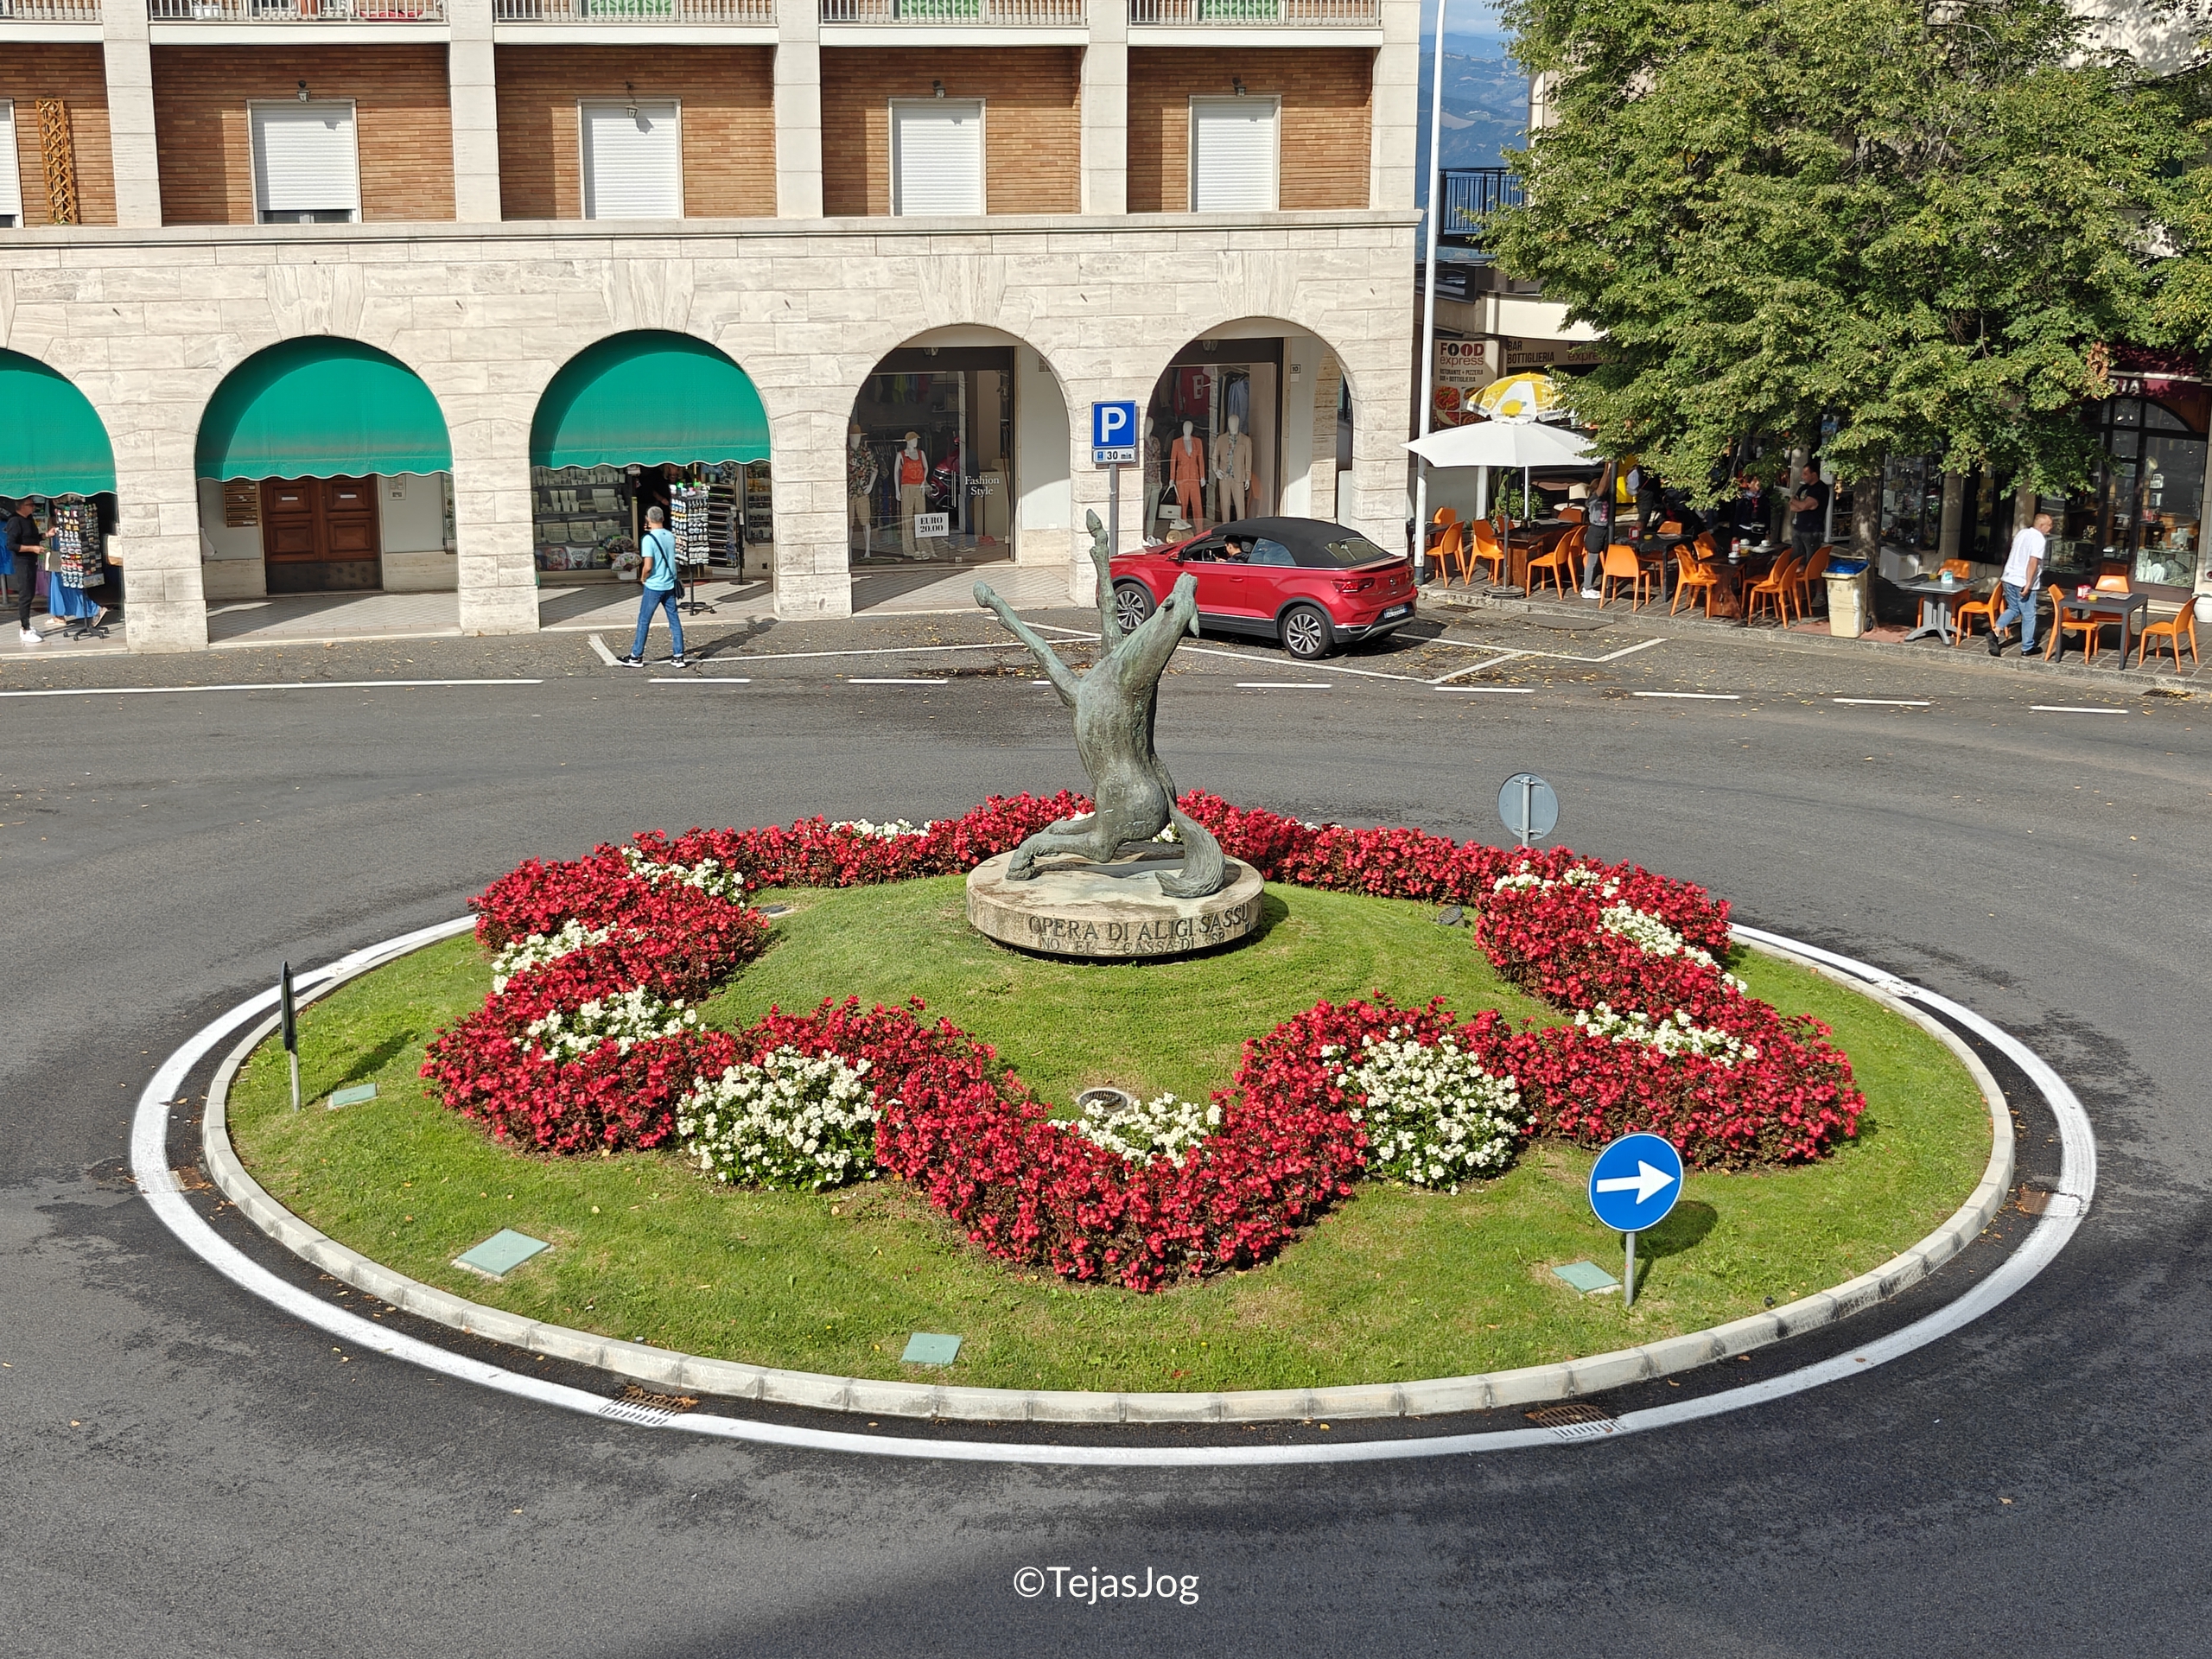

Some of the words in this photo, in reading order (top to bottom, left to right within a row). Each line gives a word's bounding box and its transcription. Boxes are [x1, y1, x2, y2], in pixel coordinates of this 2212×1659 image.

[1440, 343, 1484, 356] FOOD
[1508, 340, 1522, 352] BAR
[1440, 356, 1484, 367] express
[1507, 352, 1554, 364] BOTTIGLIERIA
[1102, 407, 1127, 442] P
[1107, 451, 1118, 460] 30
[964, 475, 1000, 485] Fashion
[970, 486, 994, 498] Style
[920, 524, 944, 533] 20.00
[1029, 916, 1099, 940] OPERA
[1108, 922, 1128, 941] DI
[1138, 918, 1193, 940] ALIGI
[1123, 938, 1175, 955] CASSA
[1180, 938, 1195, 950] DI
